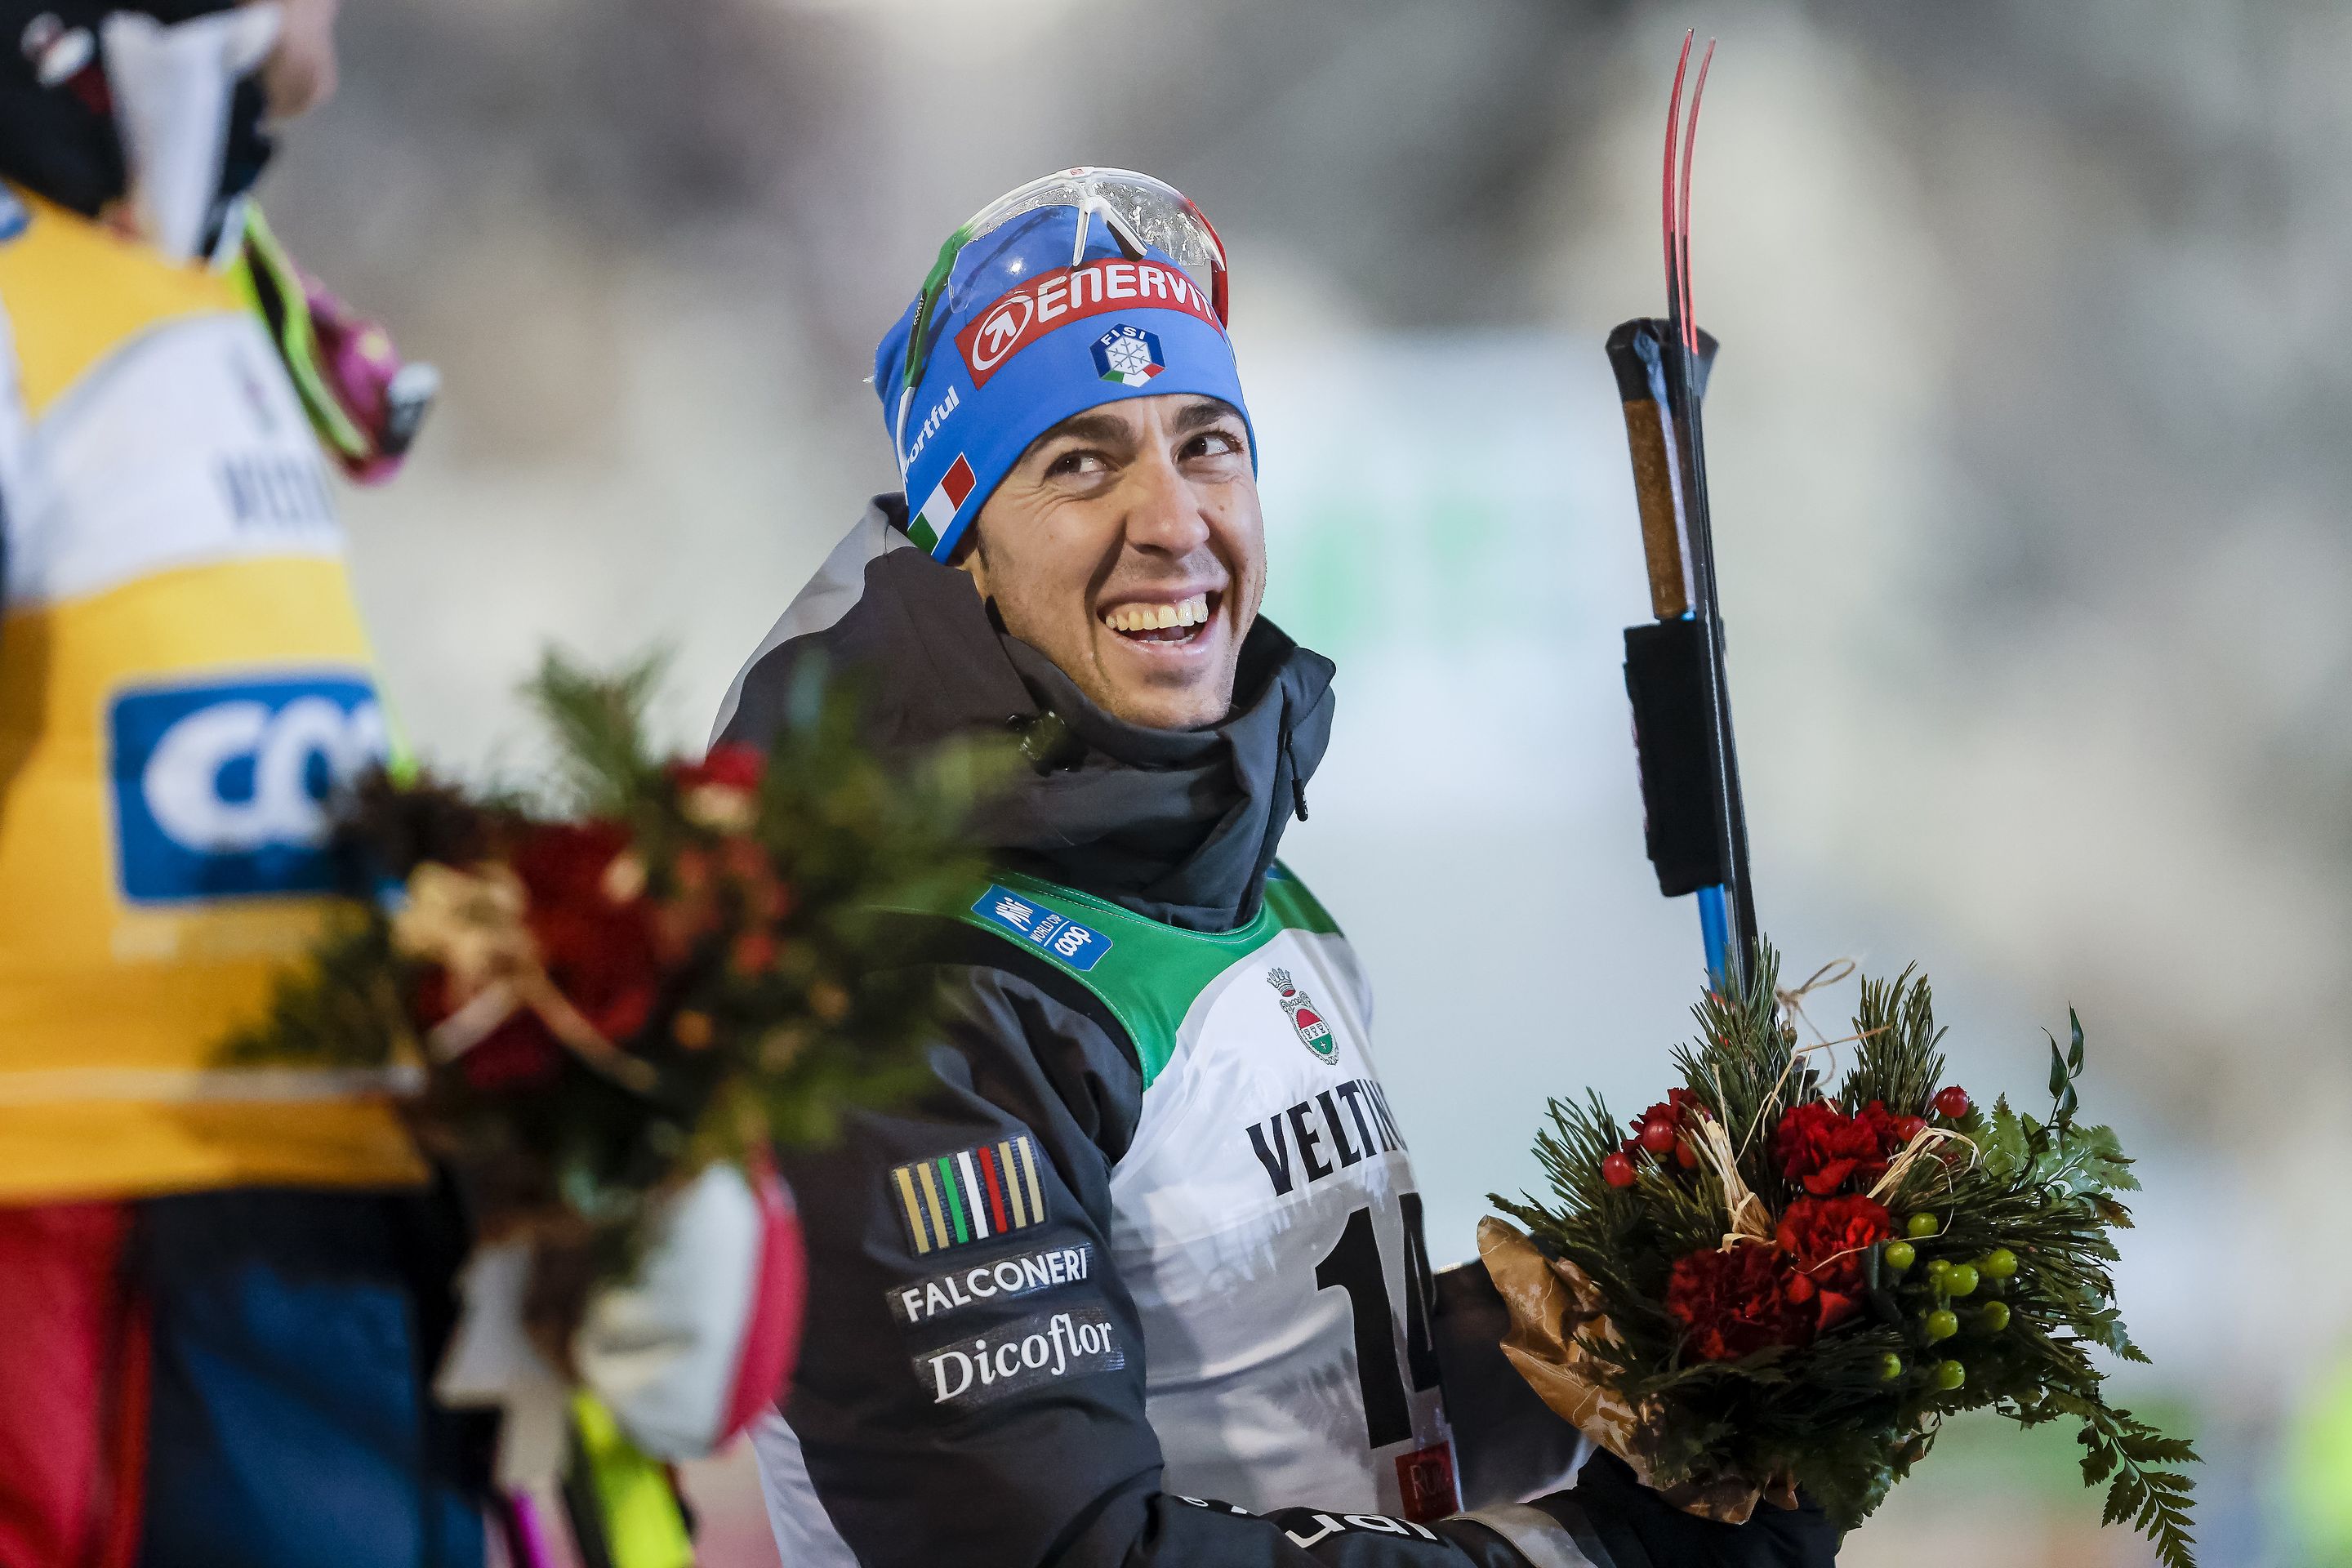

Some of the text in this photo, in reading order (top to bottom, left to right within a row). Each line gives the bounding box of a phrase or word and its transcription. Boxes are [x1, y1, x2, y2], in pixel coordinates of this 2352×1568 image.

[1100, 327, 1146, 346] FISI
[1029, 920, 1054, 943] WORLD
[1054, 926, 1093, 956] coop
[901, 1247, 1088, 1323] FALCONERI
[928, 1312, 1113, 1404] Dicoflor
